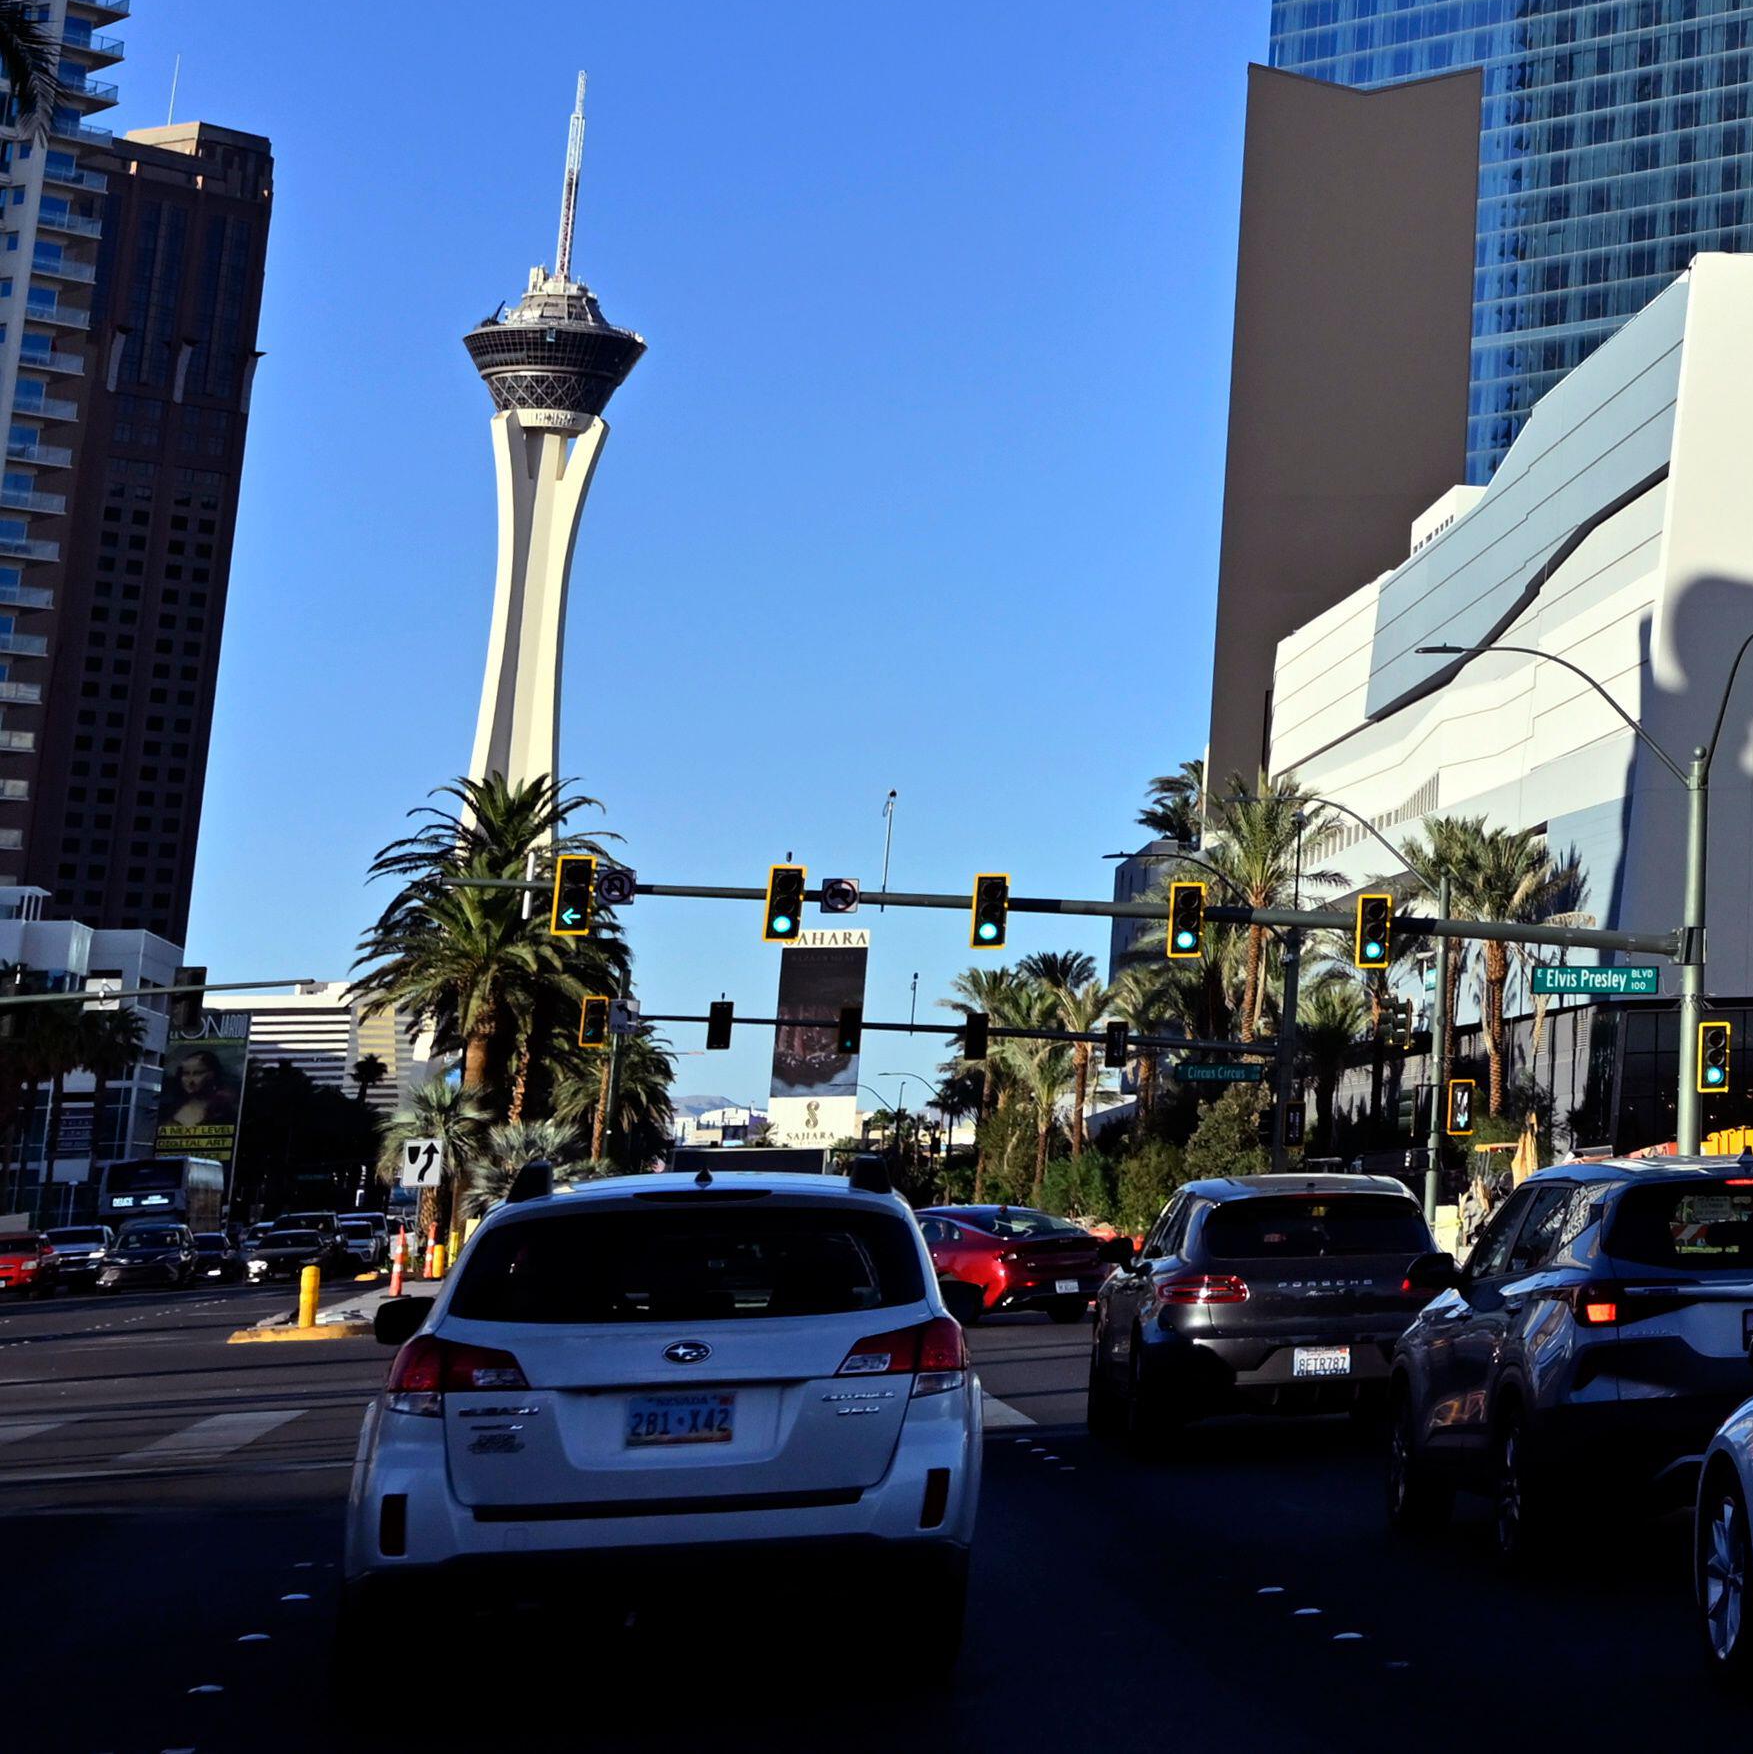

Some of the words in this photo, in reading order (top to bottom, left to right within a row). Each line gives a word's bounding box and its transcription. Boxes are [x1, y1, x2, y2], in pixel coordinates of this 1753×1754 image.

[785, 932, 867, 946] AHARA
[1537, 969, 1542, 977] E
[1546, 969, 1577, 987] Elvis
[1580, 969, 1627, 992] Presley
[1631, 969, 1654, 978] BLVD
[1631, 981, 1647, 990] 100
[1188, 1066, 1215, 1078] Circus
[1217, 1066, 1245, 1078] Circus
[159, 1126, 167, 1135] A
[169, 1126, 198, 1135] NEXT
[201, 1126, 234, 1134] LEVEL
[786, 1132, 835, 1141] SAHARA
[159, 1139, 202, 1148] DIGITAL
[204, 1139, 227, 1147] ART
[1278, 1279, 1373, 1287] PORSCHE
[1299, 1358, 1346, 1371] 8ETR787
